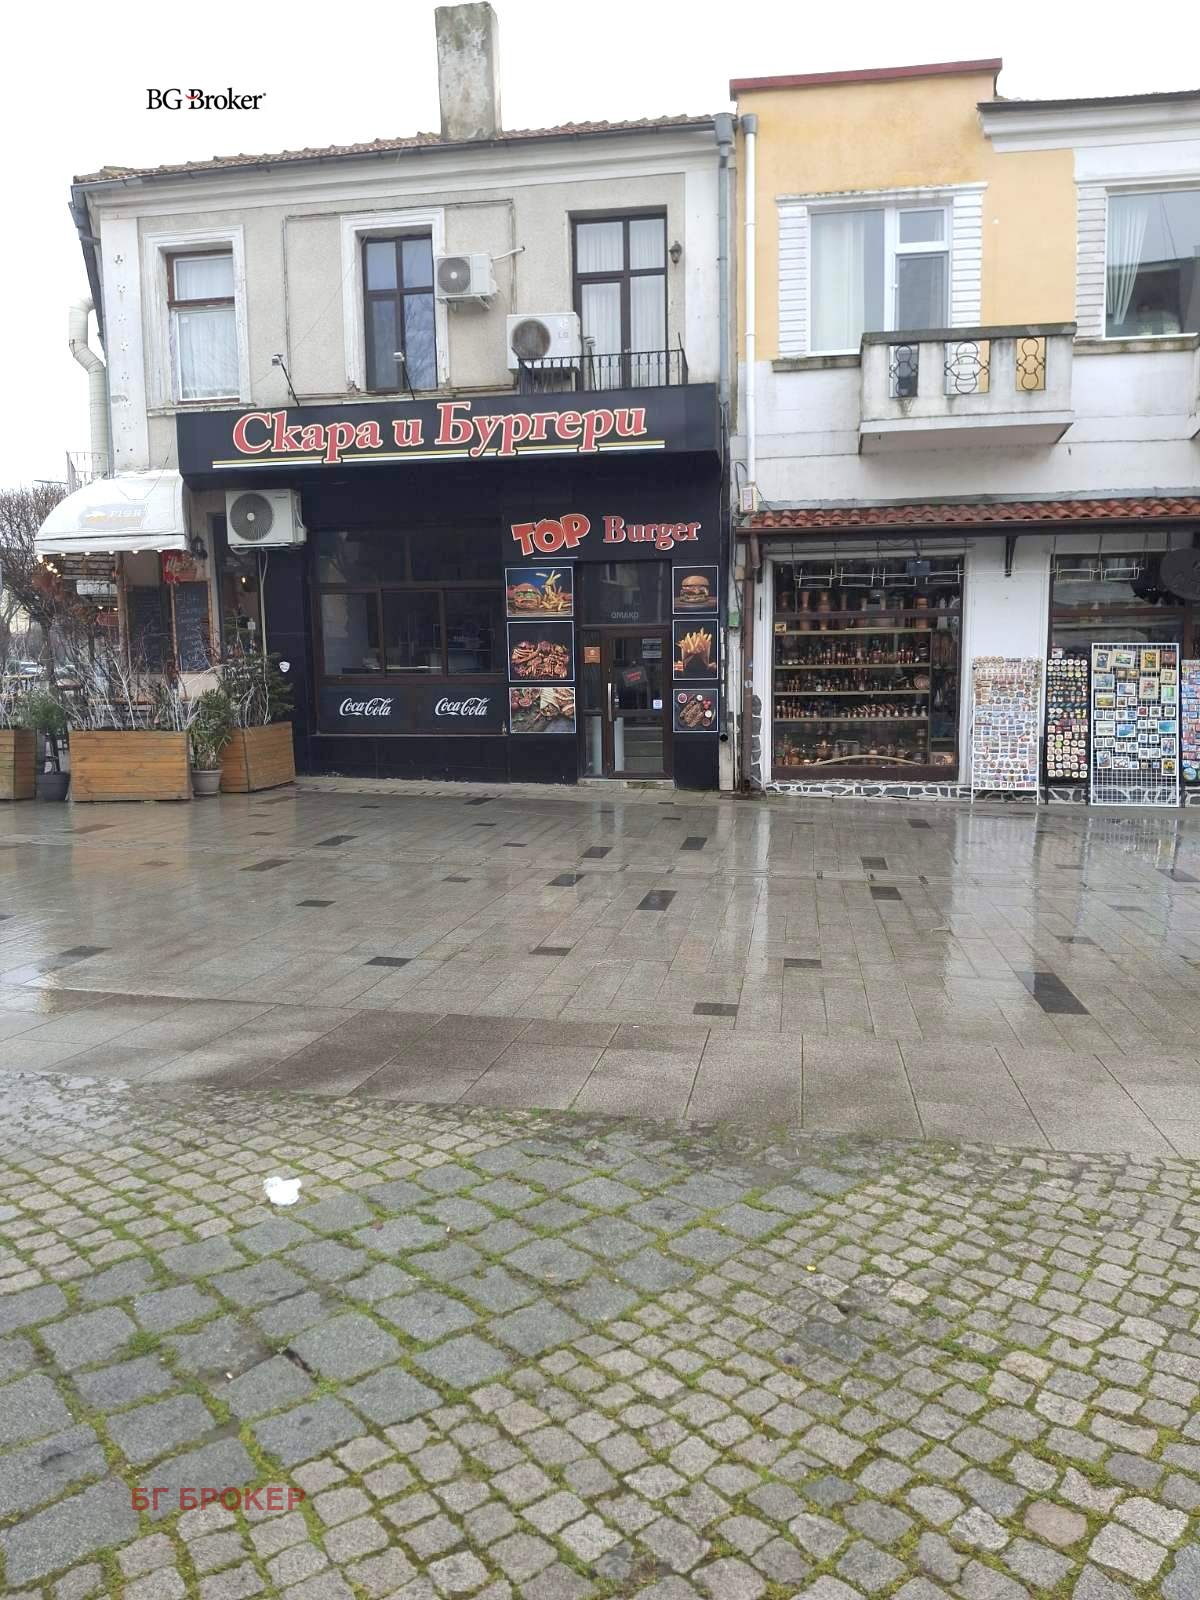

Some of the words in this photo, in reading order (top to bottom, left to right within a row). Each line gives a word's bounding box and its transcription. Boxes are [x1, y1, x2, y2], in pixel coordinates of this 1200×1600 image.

[232, 410, 383, 464] Скара
[392, 418, 425, 448] и
[433, 401, 648, 459] Бургери
[511, 513, 591, 556] TOP
[602, 515, 702, 550] Burger
